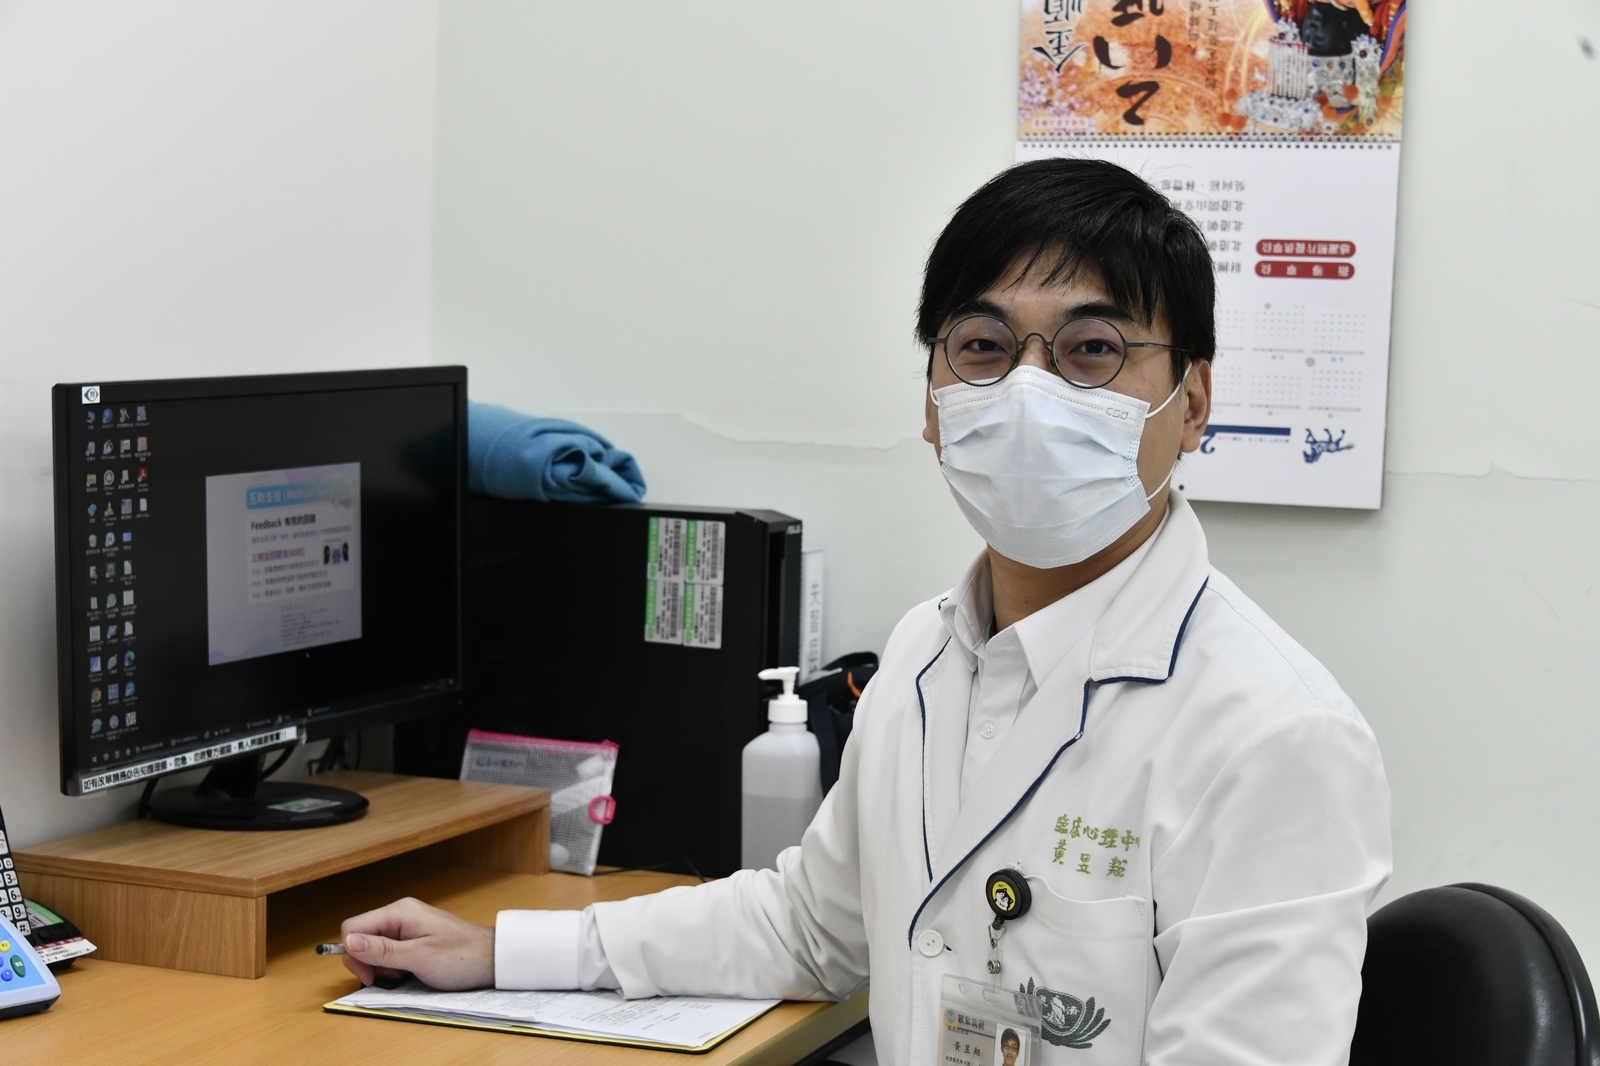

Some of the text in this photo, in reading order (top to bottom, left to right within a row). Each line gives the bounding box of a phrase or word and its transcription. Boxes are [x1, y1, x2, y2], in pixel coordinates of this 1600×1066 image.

[1261, 242, 1351, 256] 感謝照片提供單位
[1260, 263, 1350, 277] 指導單位
[250, 517, 283, 531] Feedback
[5, 873, 13, 884] 3
[10, 890, 17, 901] 6
[14, 906, 21, 918] 9
